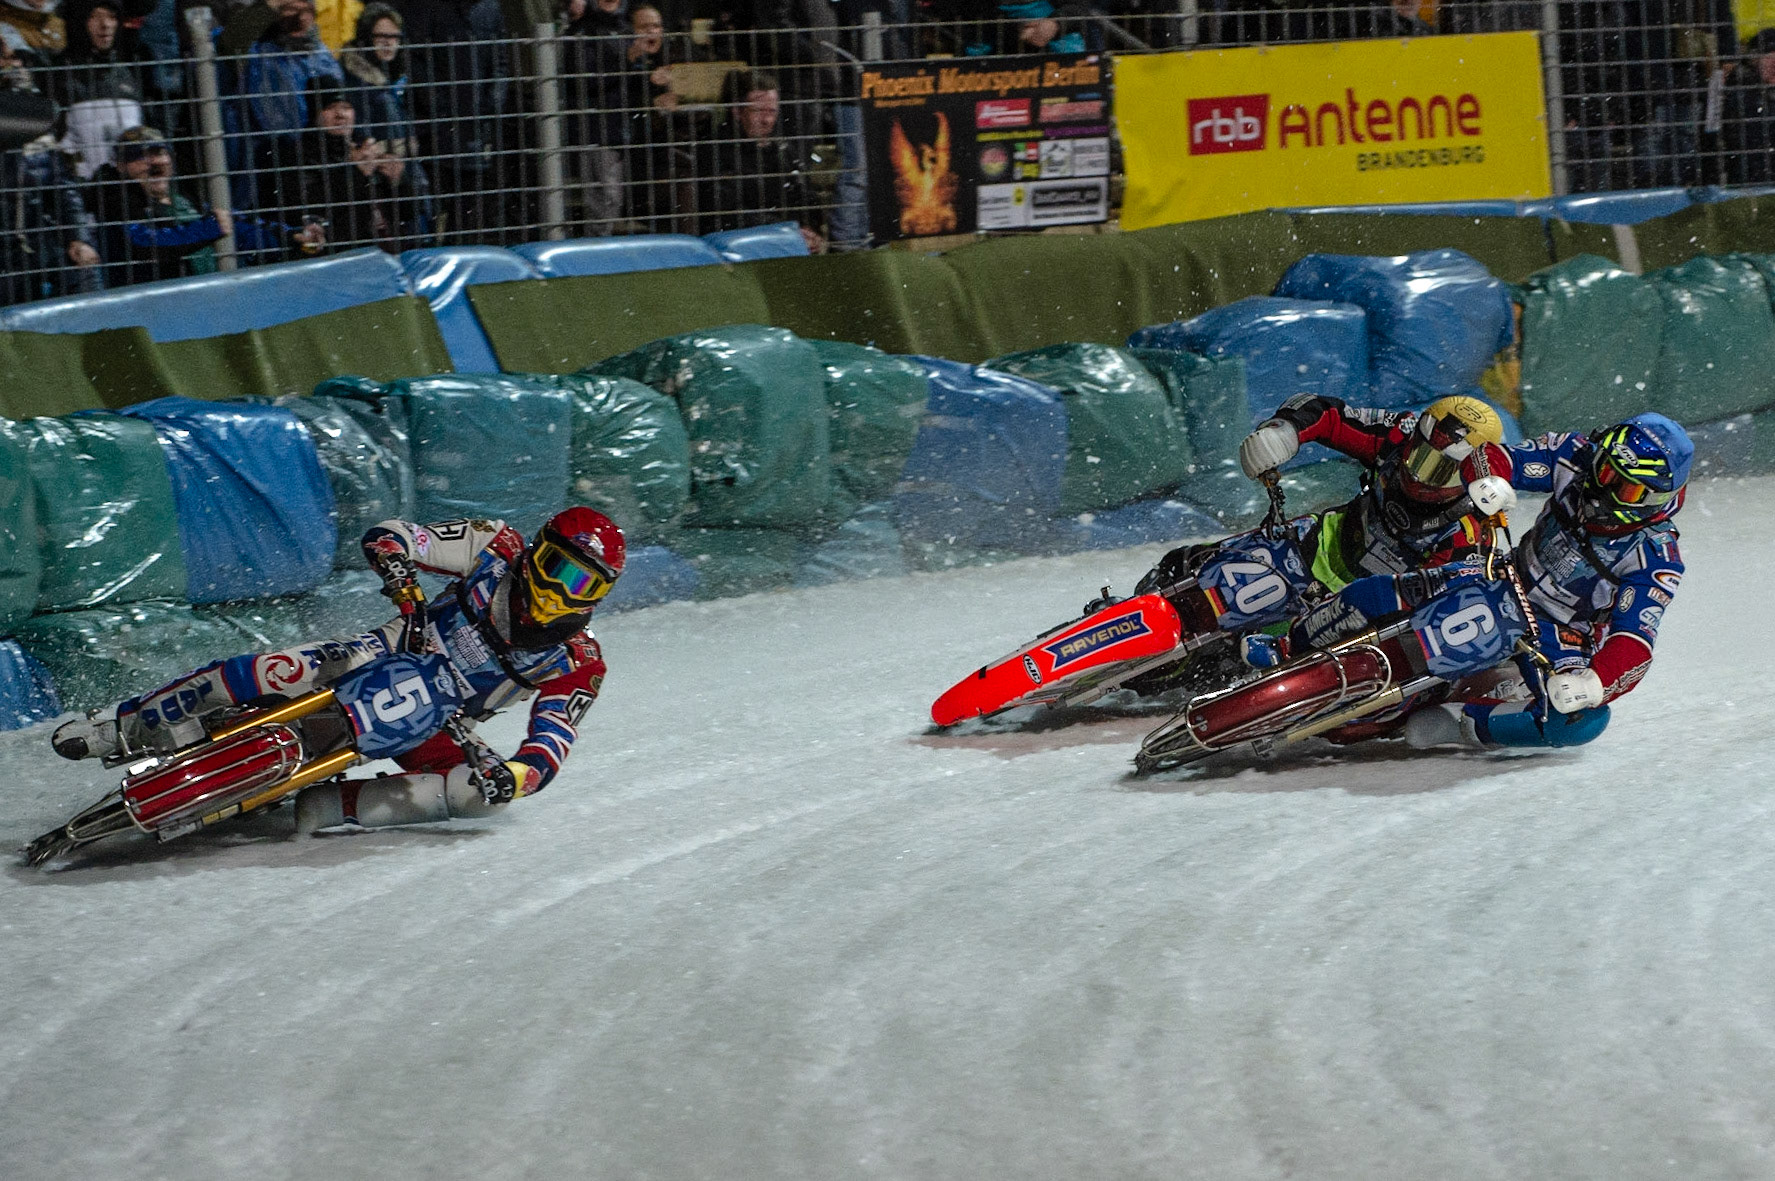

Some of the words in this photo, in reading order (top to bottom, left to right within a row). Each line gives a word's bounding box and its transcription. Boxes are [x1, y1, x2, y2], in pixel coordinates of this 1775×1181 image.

[1193, 107, 1261, 144] rbb
[1278, 87, 1482, 149] Antenne
[1356, 145, 1485, 171] BRANDENBURG
[1220, 547, 1287, 614] 20
[1059, 617, 1141, 659] RAVENOL
[1440, 602, 1495, 648] 6
[1023, 655, 1042, 684] HJC
[372, 674, 432, 723] 5
